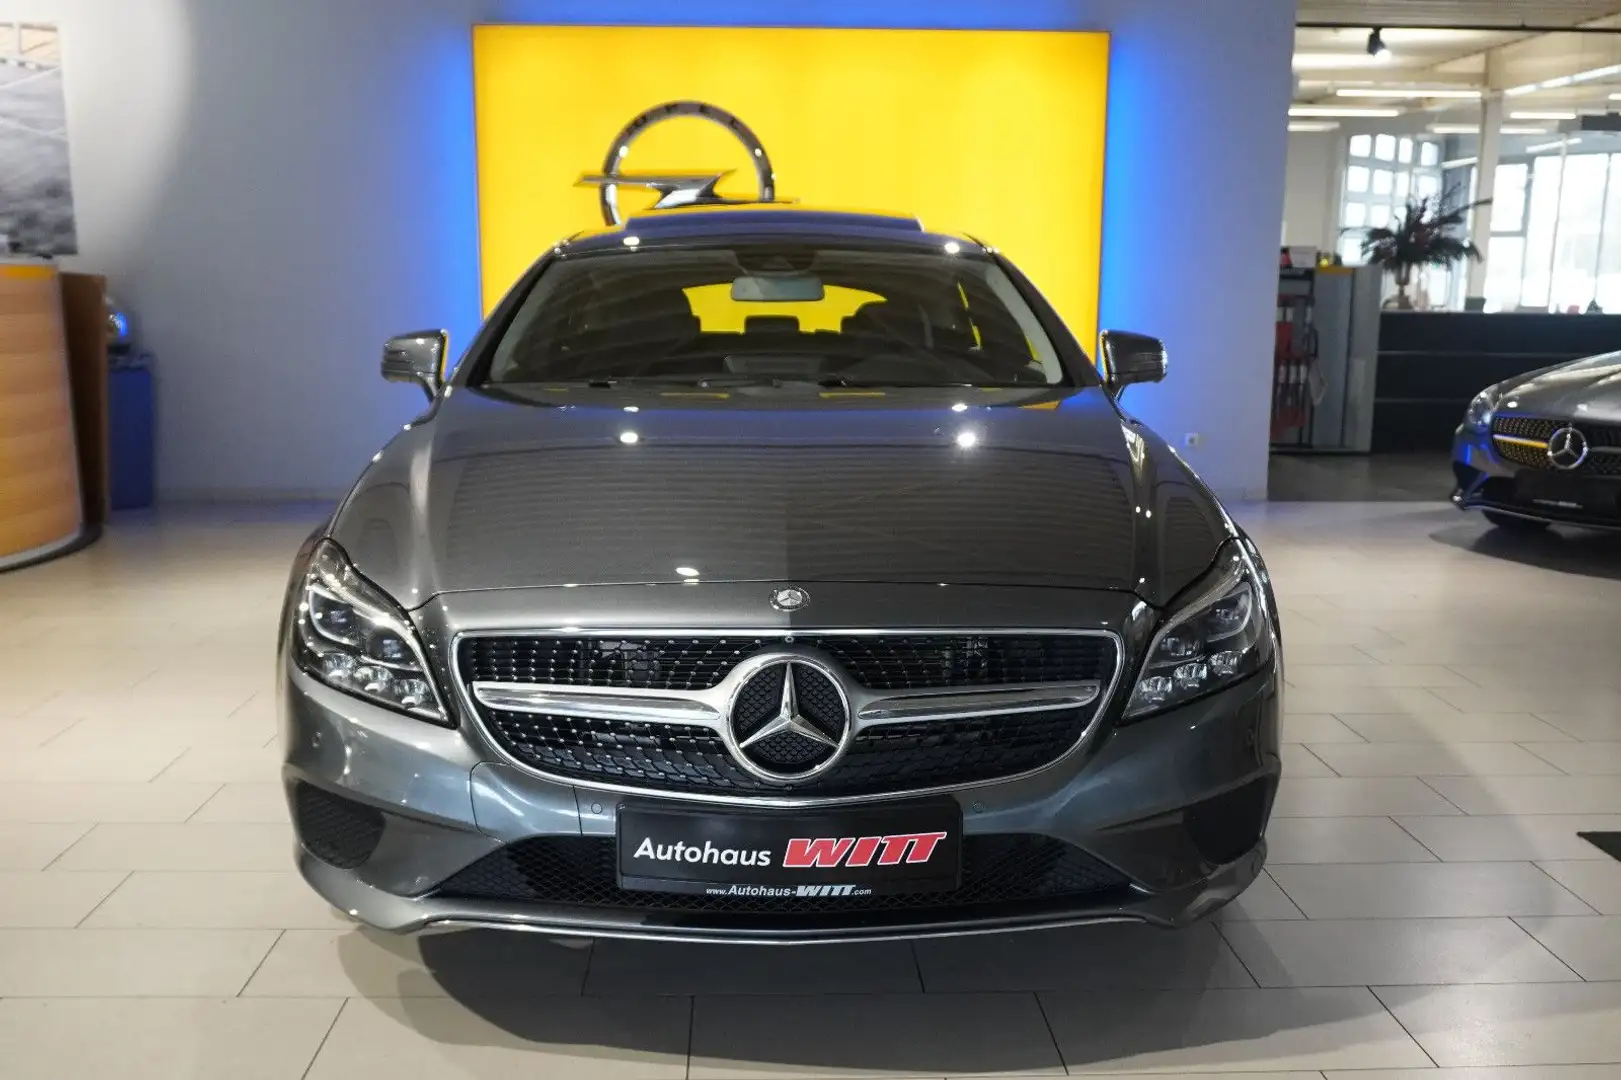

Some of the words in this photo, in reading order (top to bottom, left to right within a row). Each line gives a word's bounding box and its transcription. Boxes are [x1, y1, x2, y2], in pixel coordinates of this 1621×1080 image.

[633, 837, 772, 866] Autohaus
[782, 831, 947, 868] WITT
[705, 884, 872, 897] www.Autohaus-WITT.com
